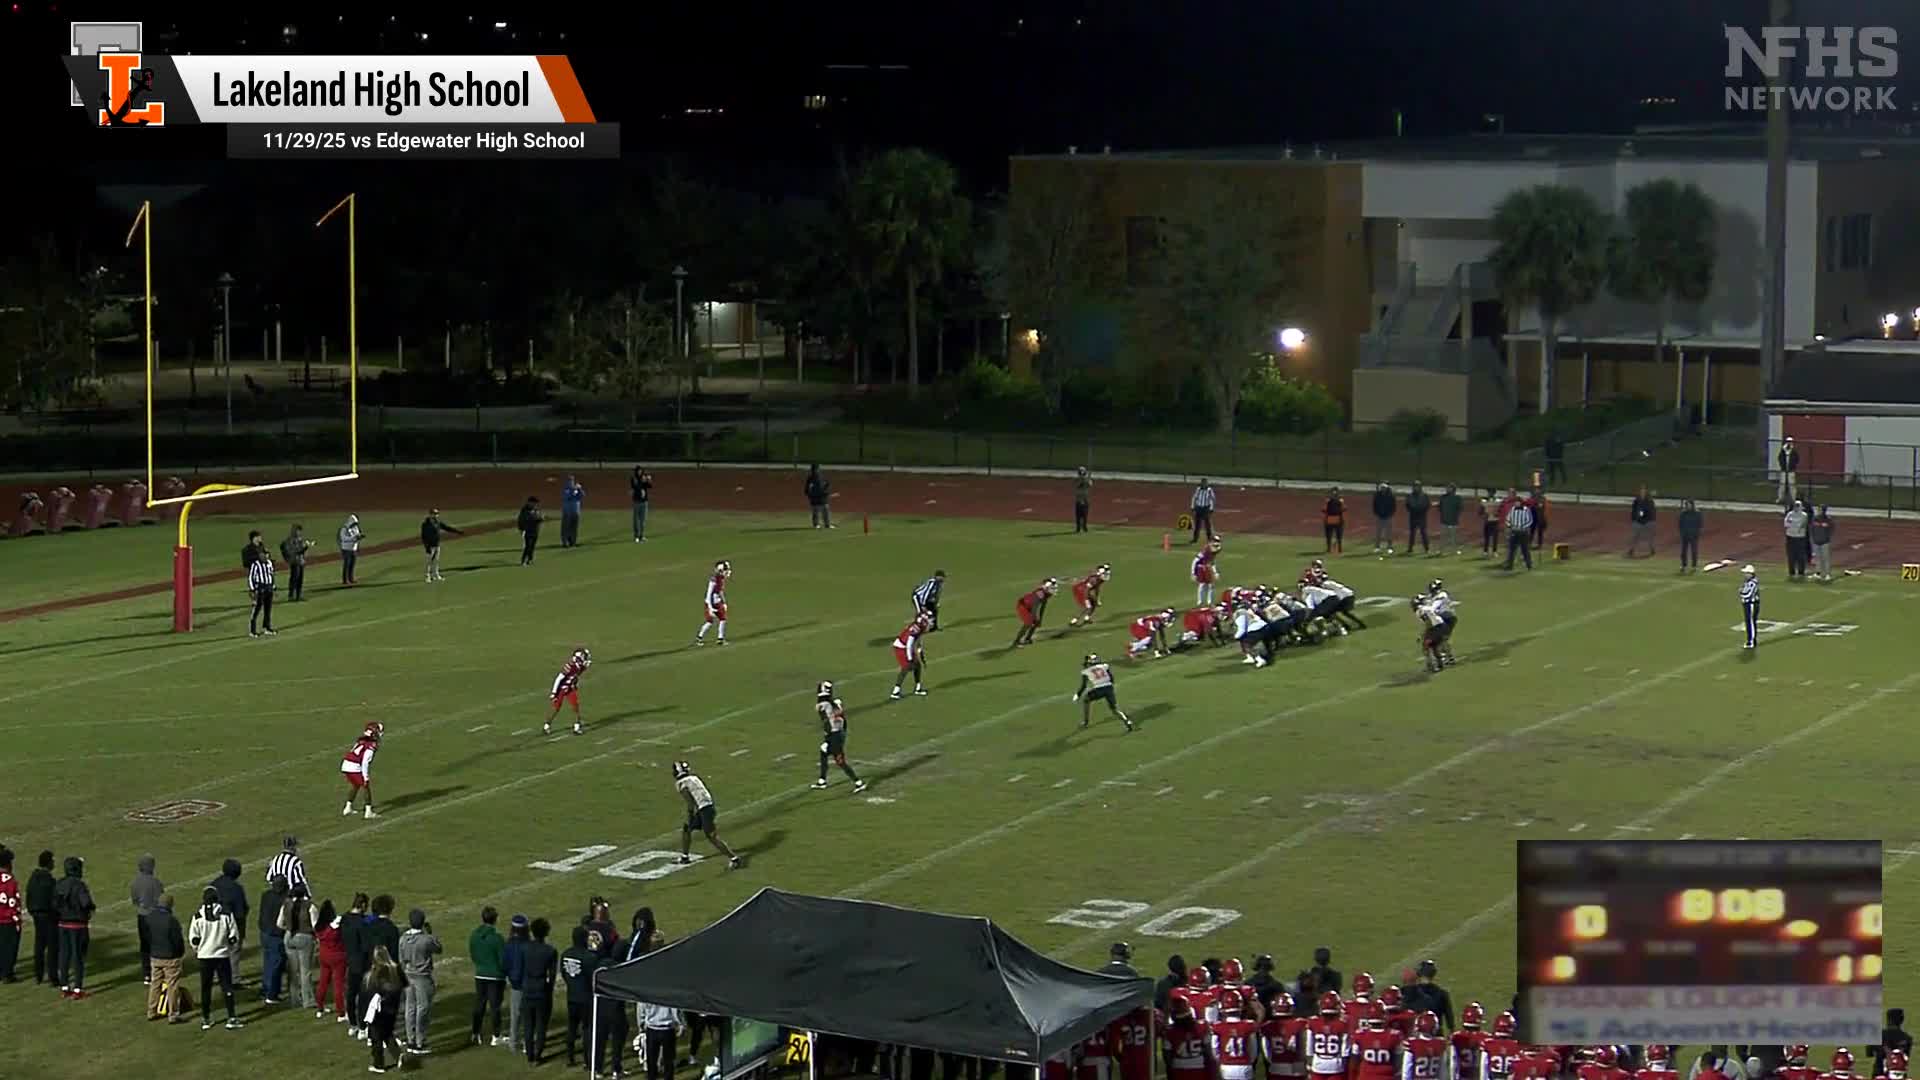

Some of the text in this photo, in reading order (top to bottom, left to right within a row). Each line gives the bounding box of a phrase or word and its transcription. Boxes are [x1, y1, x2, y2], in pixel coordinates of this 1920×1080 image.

[1904, 566, 1918, 580] 20
[527, 844, 704, 880] 10
[1046, 899, 1243, 939] 20
[1599, 1018, 1880, 1040] AdventHealth
[1176, 1039, 1203, 1058] 45
[1224, 1036, 1244, 1057] 41
[1271, 1035, 1297, 1054] 54
[1314, 1033, 1339, 1054] 26
